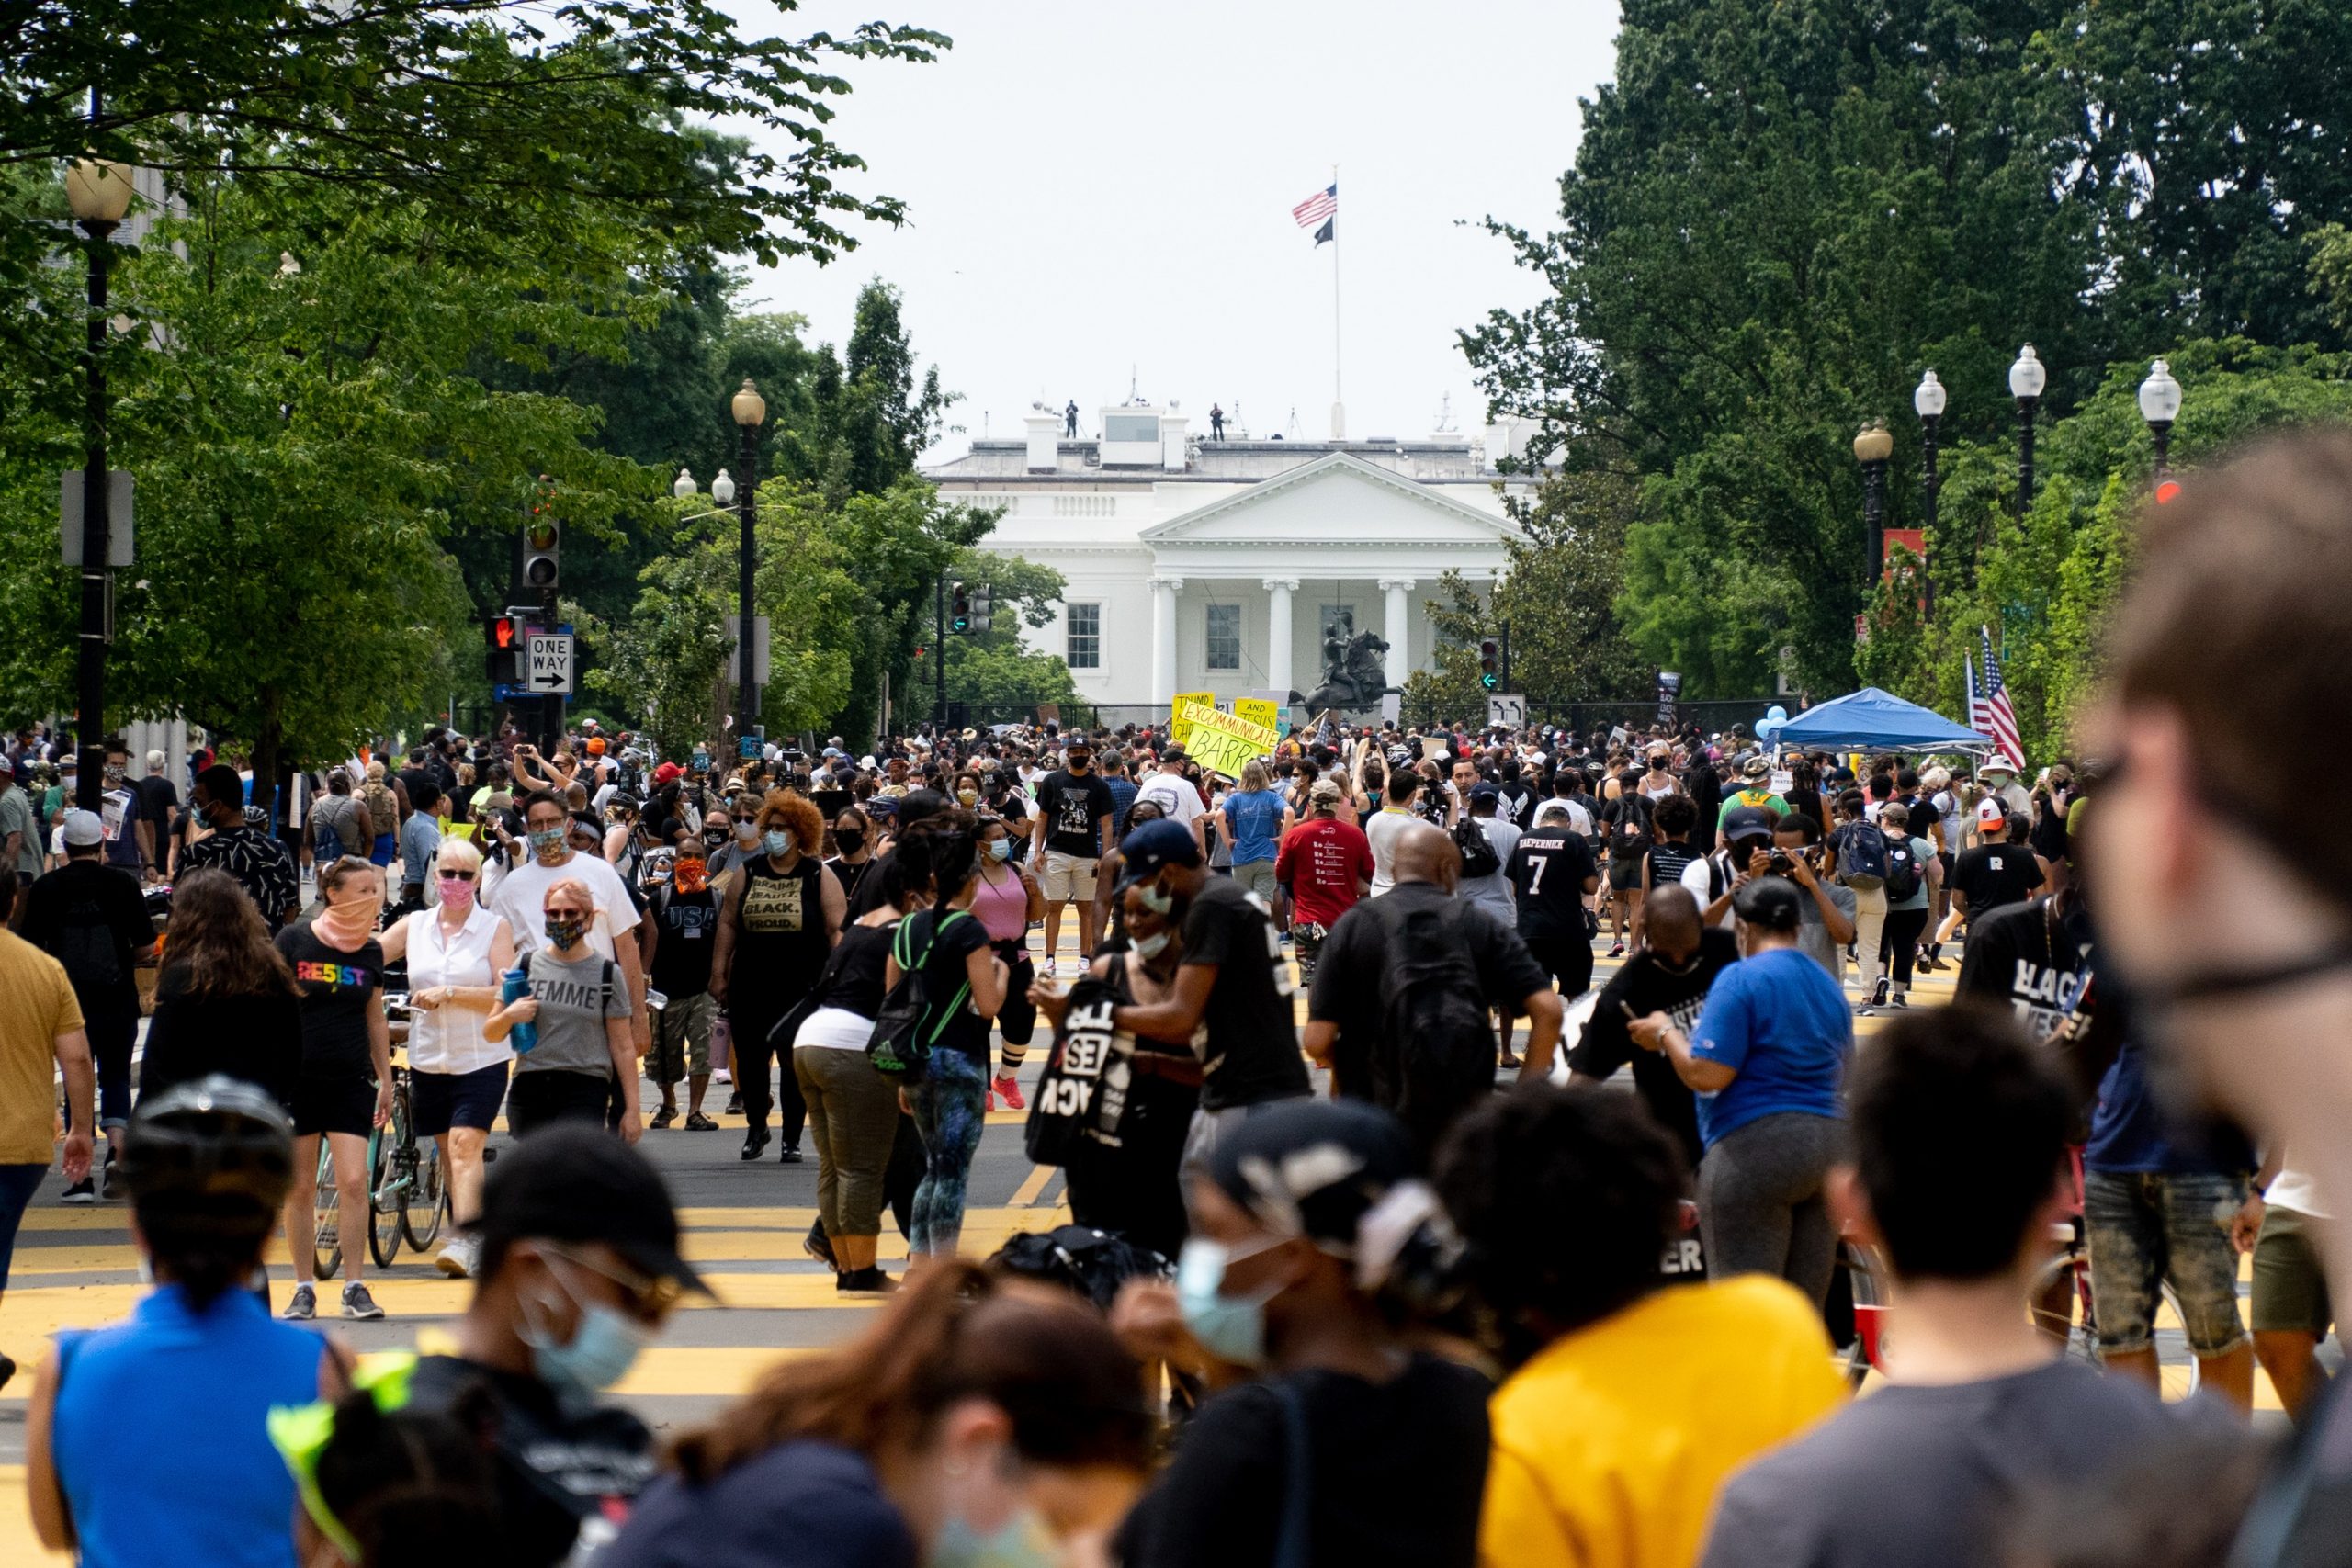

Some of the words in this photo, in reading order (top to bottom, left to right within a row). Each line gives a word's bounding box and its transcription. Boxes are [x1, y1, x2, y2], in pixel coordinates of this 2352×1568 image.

[534, 639, 567, 654] ONE
[533, 656, 567, 670] WAY
[1247, 703, 1266, 713] AND
[1184, 703, 1279, 748] EXCOMMUNICATE
[1191, 730, 1253, 773] BARR
[1519, 837, 1566, 850] KAEPERNICK
[1989, 856, 2003, 870] R
[1527, 855, 1548, 895] 7
[744, 902, 800, 915] BLACK.
[748, 918, 796, 930] PROUD.
